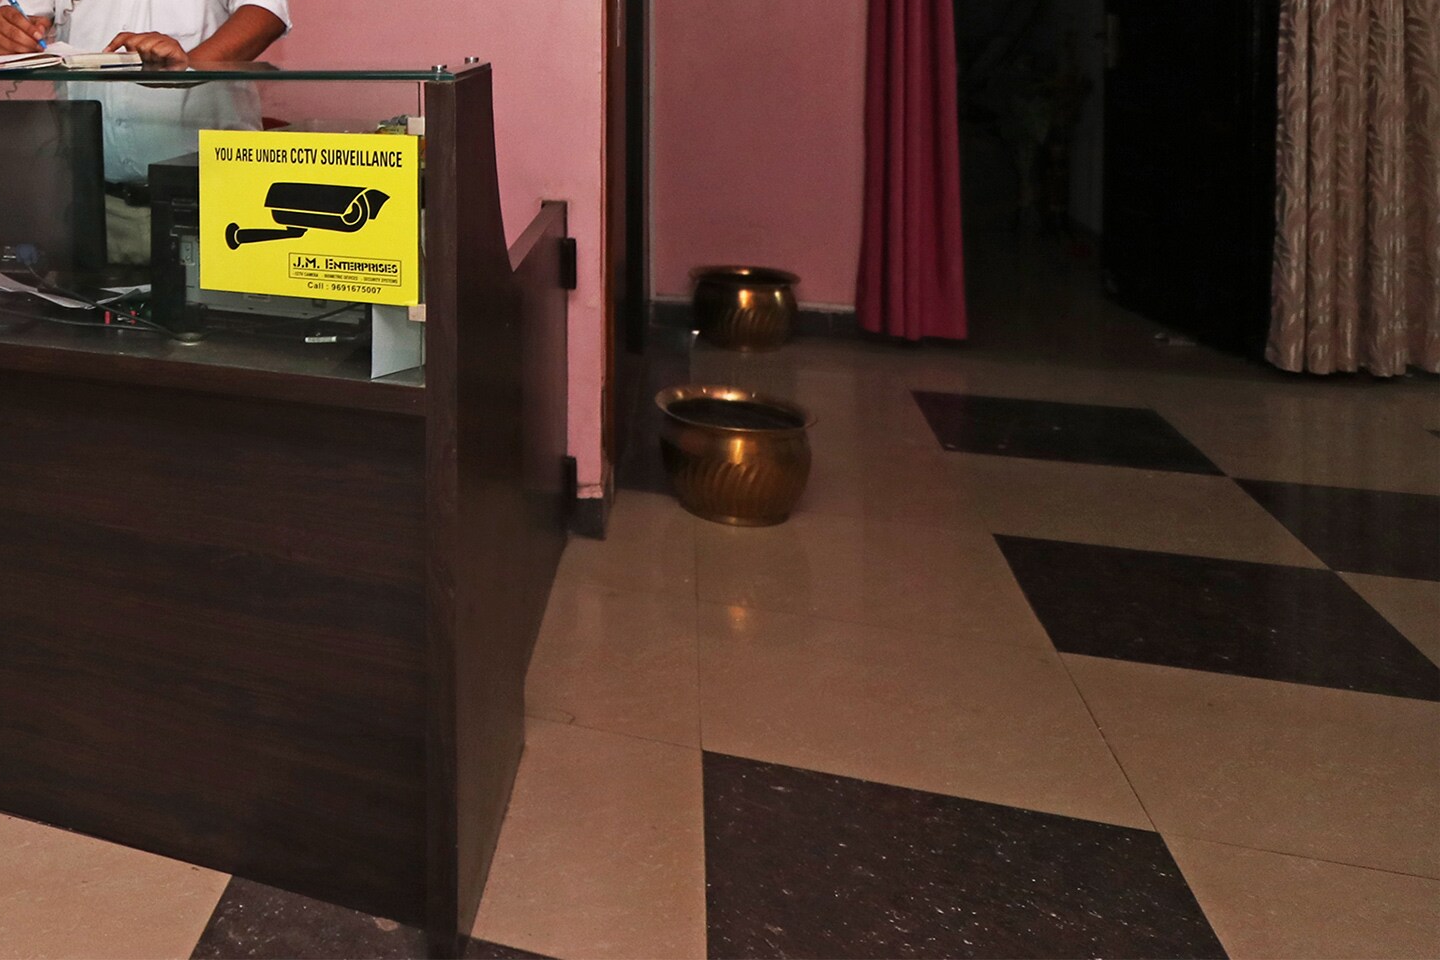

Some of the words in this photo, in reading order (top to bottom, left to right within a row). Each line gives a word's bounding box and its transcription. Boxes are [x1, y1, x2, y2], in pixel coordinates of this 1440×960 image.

[215, 147, 233, 161] YOU
[235, 148, 253, 162] ARE
[256, 149, 288, 163] UNDER
[290, 148, 318, 164] CCTV
[320, 149, 402, 168] SURVEILLANCE
[293, 257, 320, 269] J.M.
[325, 258, 398, 274] ENTERPRISES
[307, 281, 324, 290] Call
[331, 283, 382, 294] 9691675007
